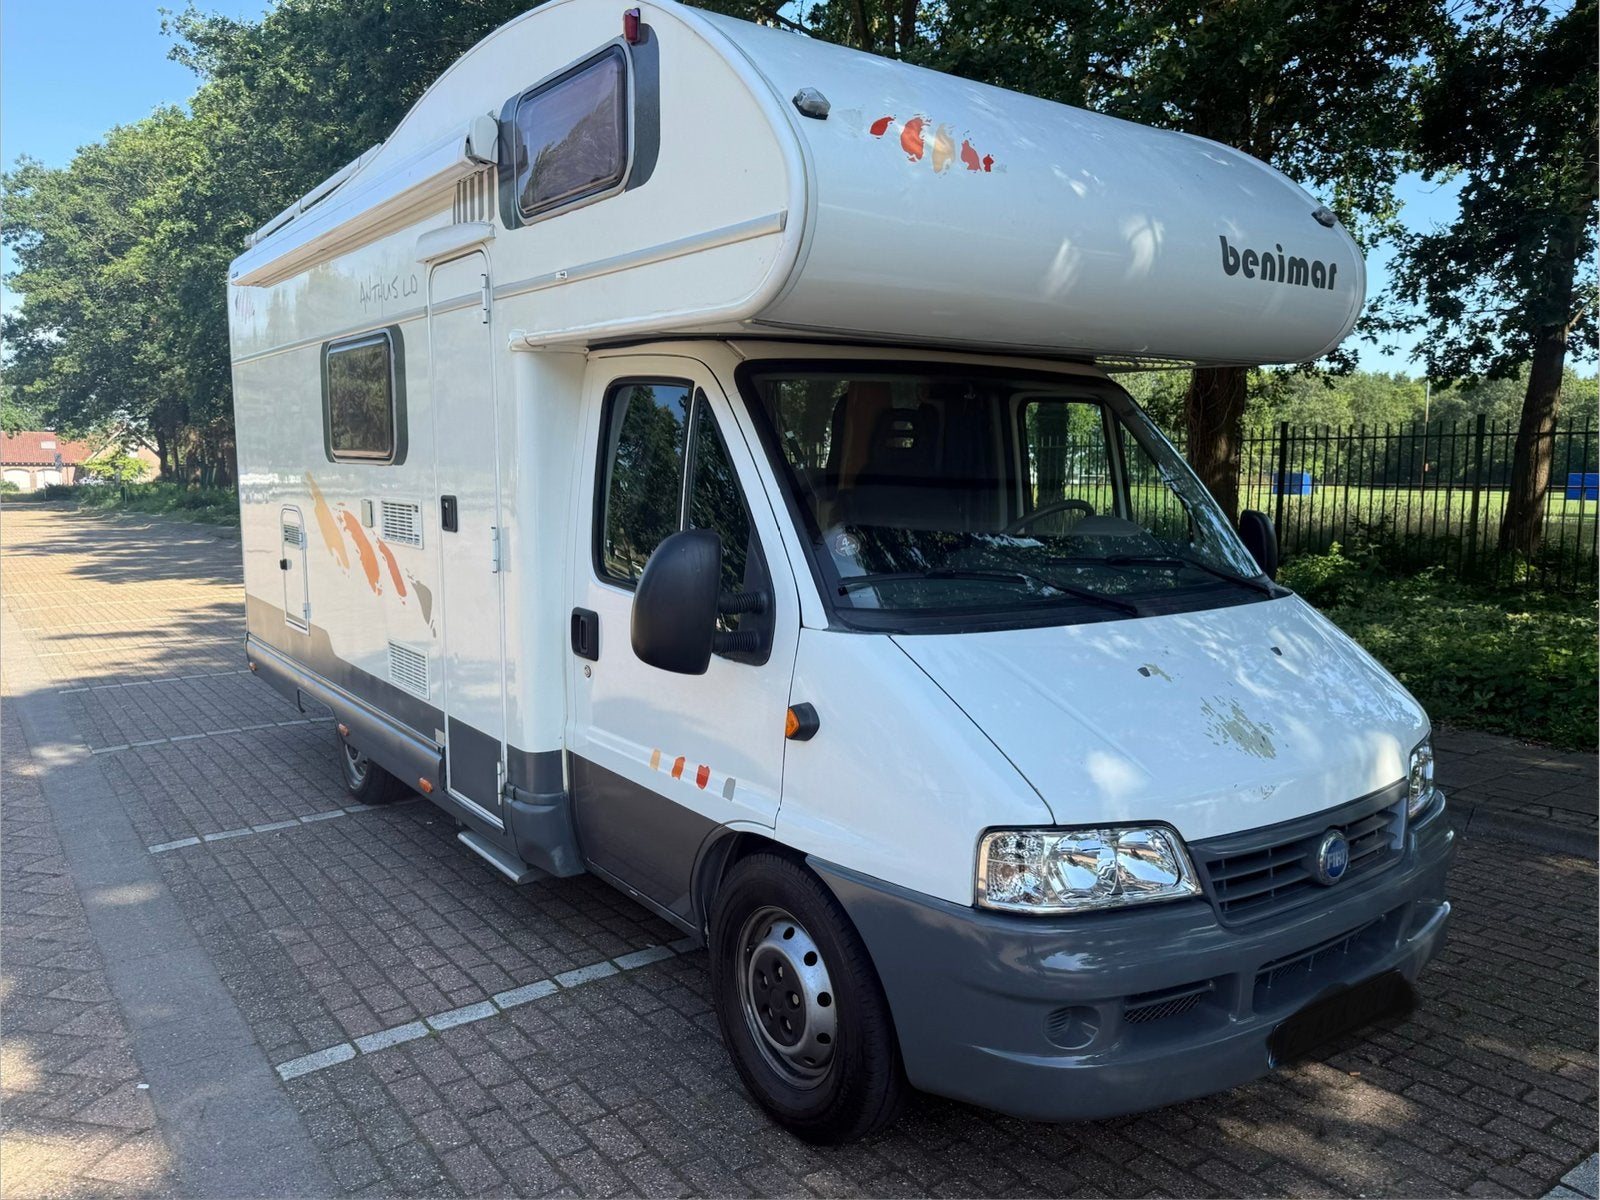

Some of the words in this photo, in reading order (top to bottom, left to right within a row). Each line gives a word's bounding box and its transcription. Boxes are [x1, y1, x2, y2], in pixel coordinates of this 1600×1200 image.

[1219, 235, 1337, 290] benimar
[360, 274, 399, 314] ANTHUS
[1327, 850, 1345, 869] FIAT
